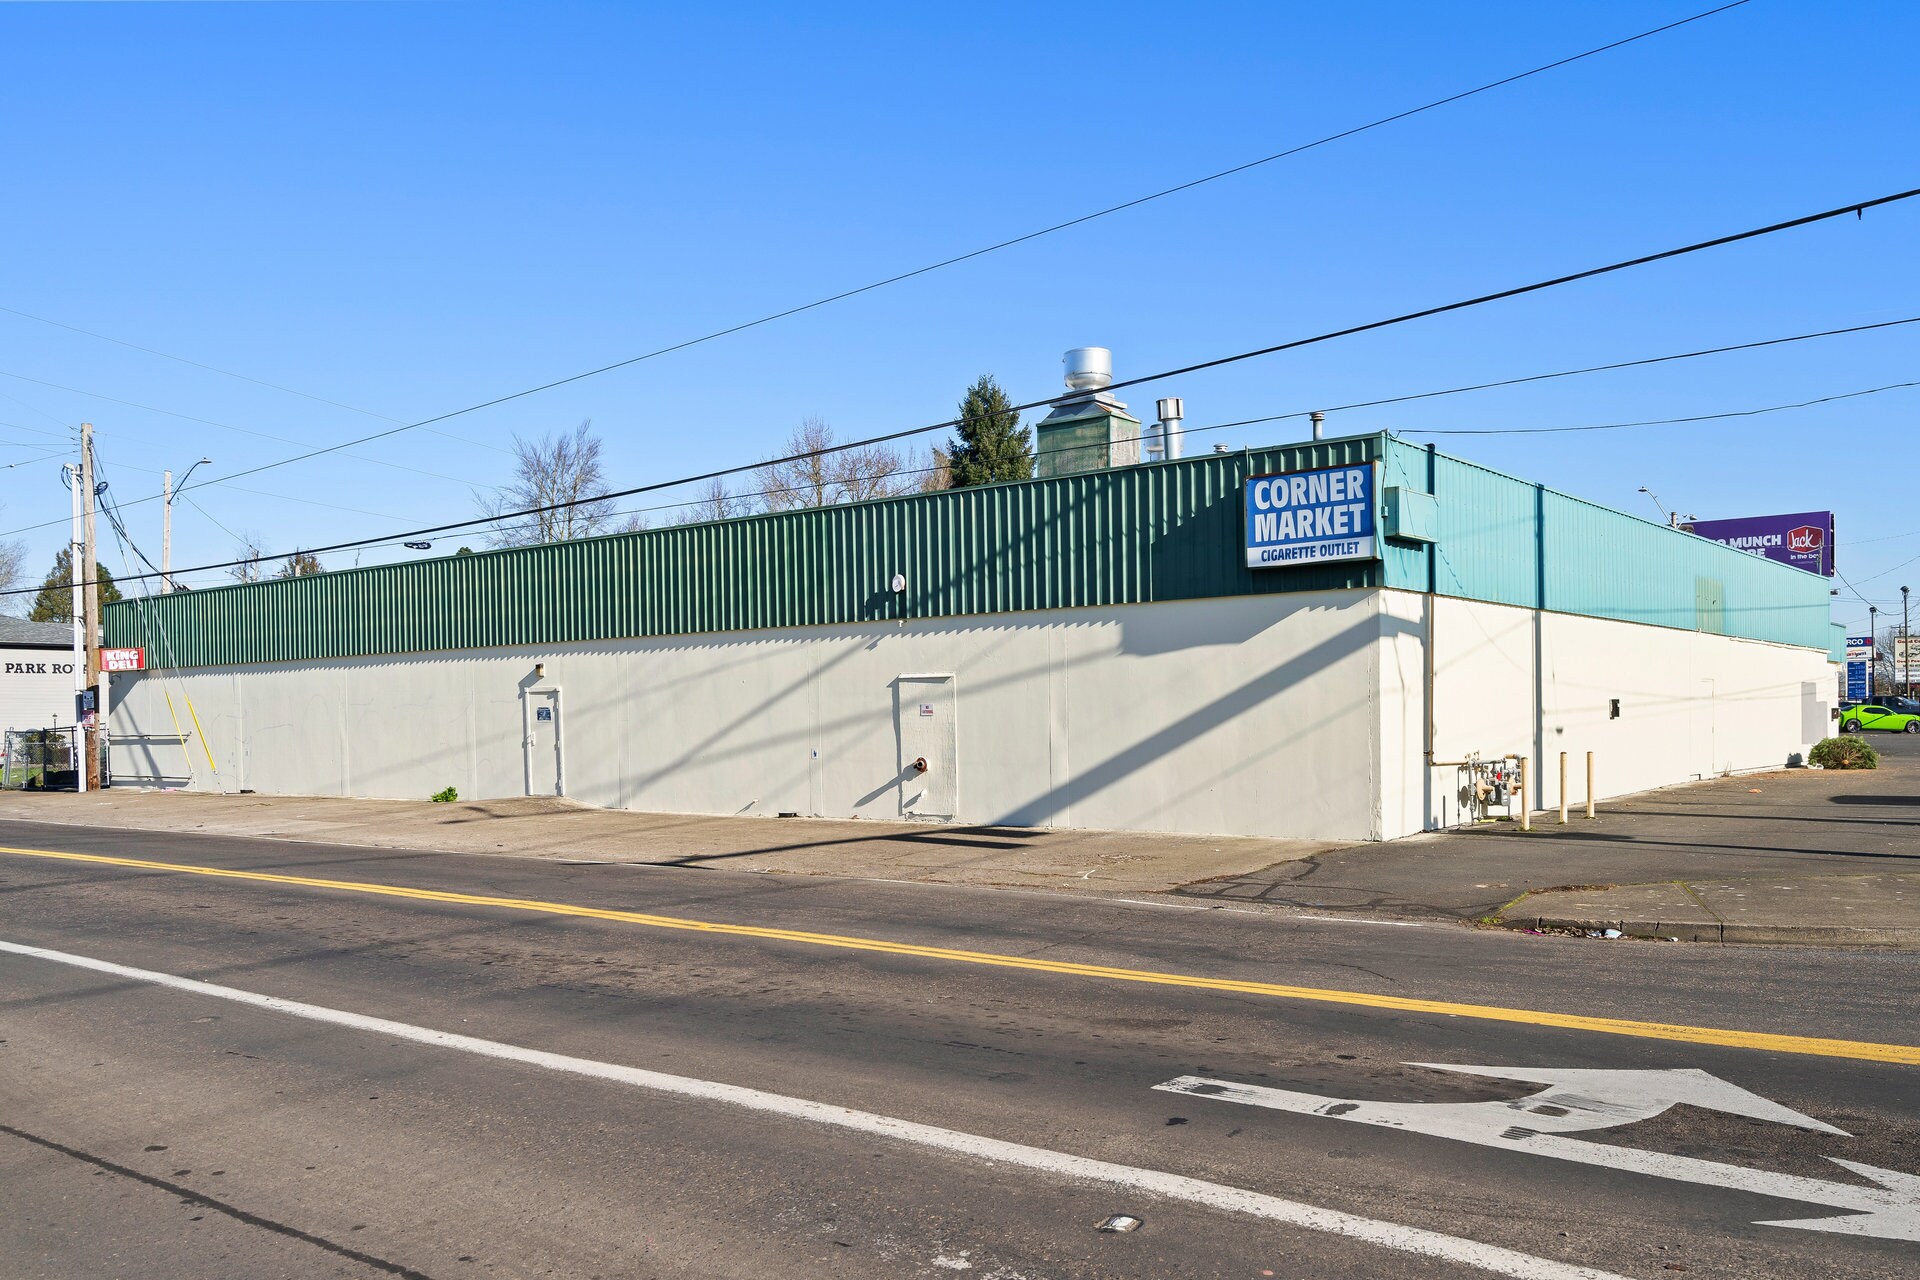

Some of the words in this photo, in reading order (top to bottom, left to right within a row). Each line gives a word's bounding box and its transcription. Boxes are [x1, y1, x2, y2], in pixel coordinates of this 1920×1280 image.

[1254, 469, 1365, 510] CORNER
[1254, 502, 1366, 543] MARKET
[1729, 534, 1782, 548] MUNCH
[1790, 529, 1820, 549] Jack
[1261, 545, 1316, 562] CIGARETTE
[1319, 541, 1360, 557] OUTLET
[106, 650, 139, 661] KING
[5, 663, 47, 674] PARK
[108, 660, 138, 670] DELI
